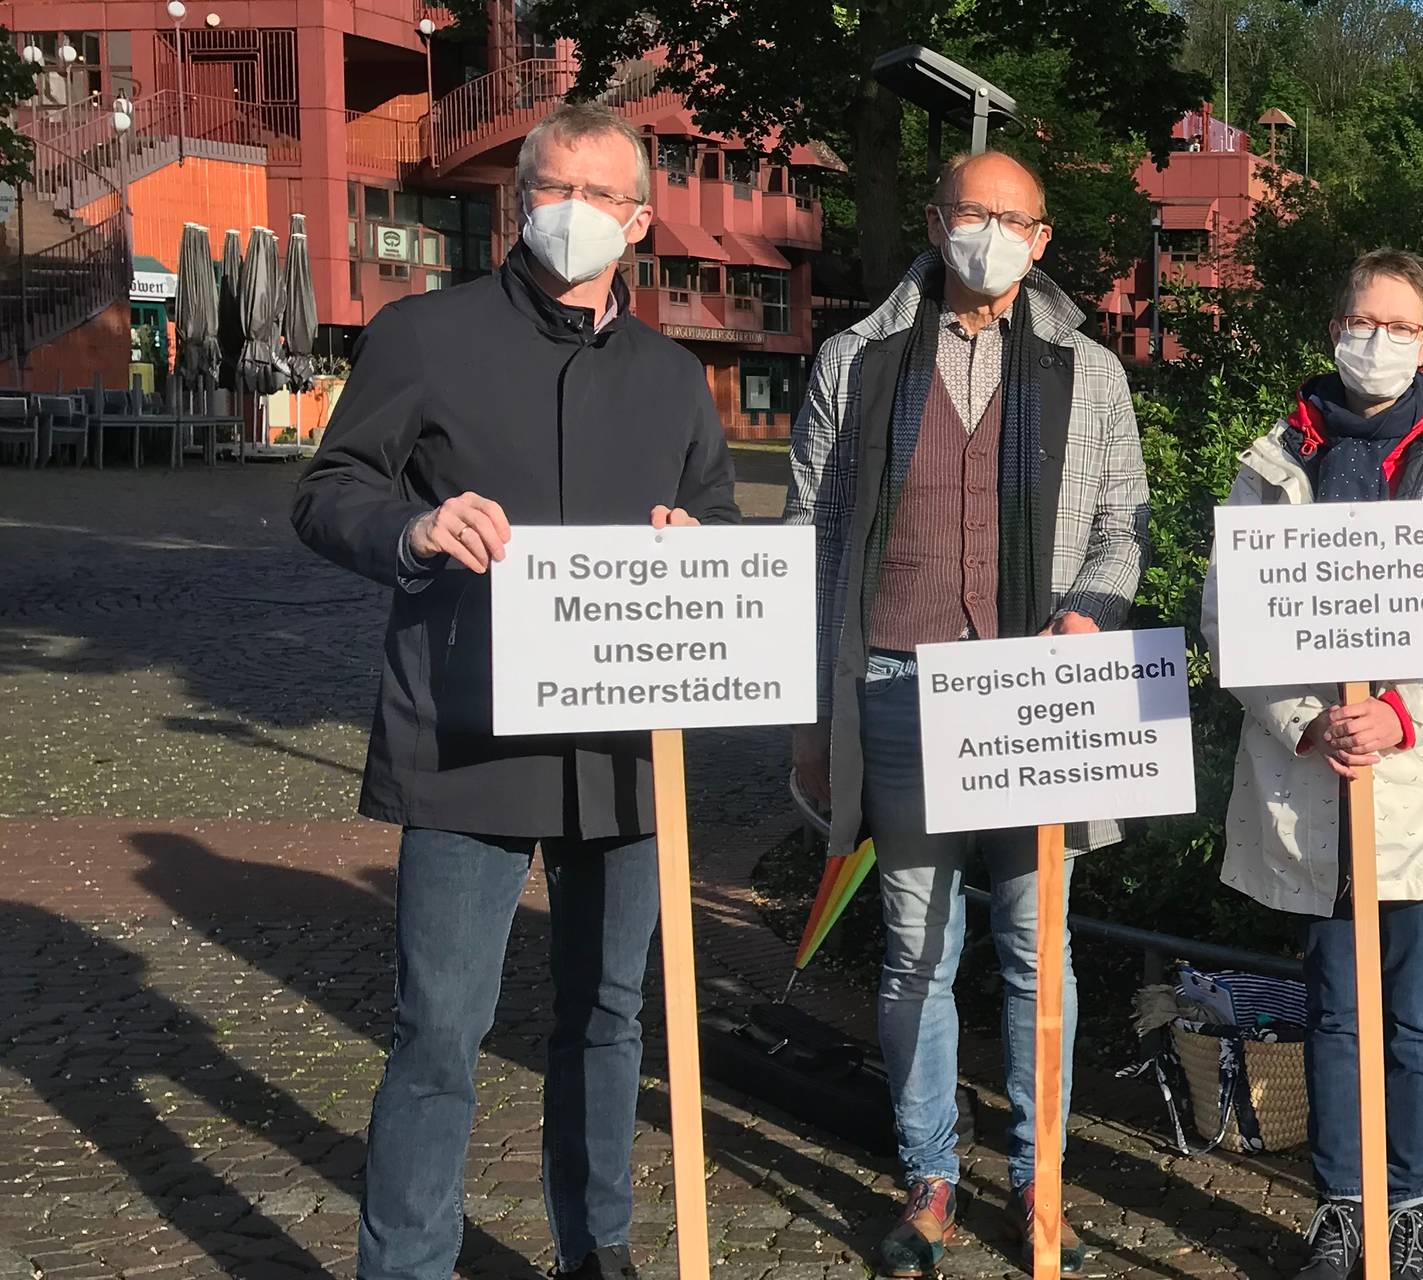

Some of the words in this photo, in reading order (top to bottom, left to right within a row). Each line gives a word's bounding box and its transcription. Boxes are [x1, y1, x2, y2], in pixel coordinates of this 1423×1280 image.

[1232, 529, 1274, 551] Für
[1284, 526, 1386, 550] Frieden,
[527, 554, 556, 580] In
[569, 553, 668, 585] Sorge
[680, 558, 729, 578] um
[741, 553, 788, 577] die
[1260, 562, 1307, 584] und
[554, 595, 723, 622] Menschen
[736, 594, 763, 618] in
[1267, 596, 1303, 618] für
[1312, 593, 1379, 616] Israel
[594, 640, 727, 663] unseren
[1296, 626, 1411, 651] Palästina
[932, 667, 1046, 696] Bergisch
[1055, 657, 1176, 685] Gladbach
[537, 676, 781, 707] Partnerstädten
[1017, 700, 1095, 726] gegen
[958, 728, 1158, 759] Antisemitismus
[962, 768, 1009, 791] und
[1019, 761, 1159, 788] Rassismus
